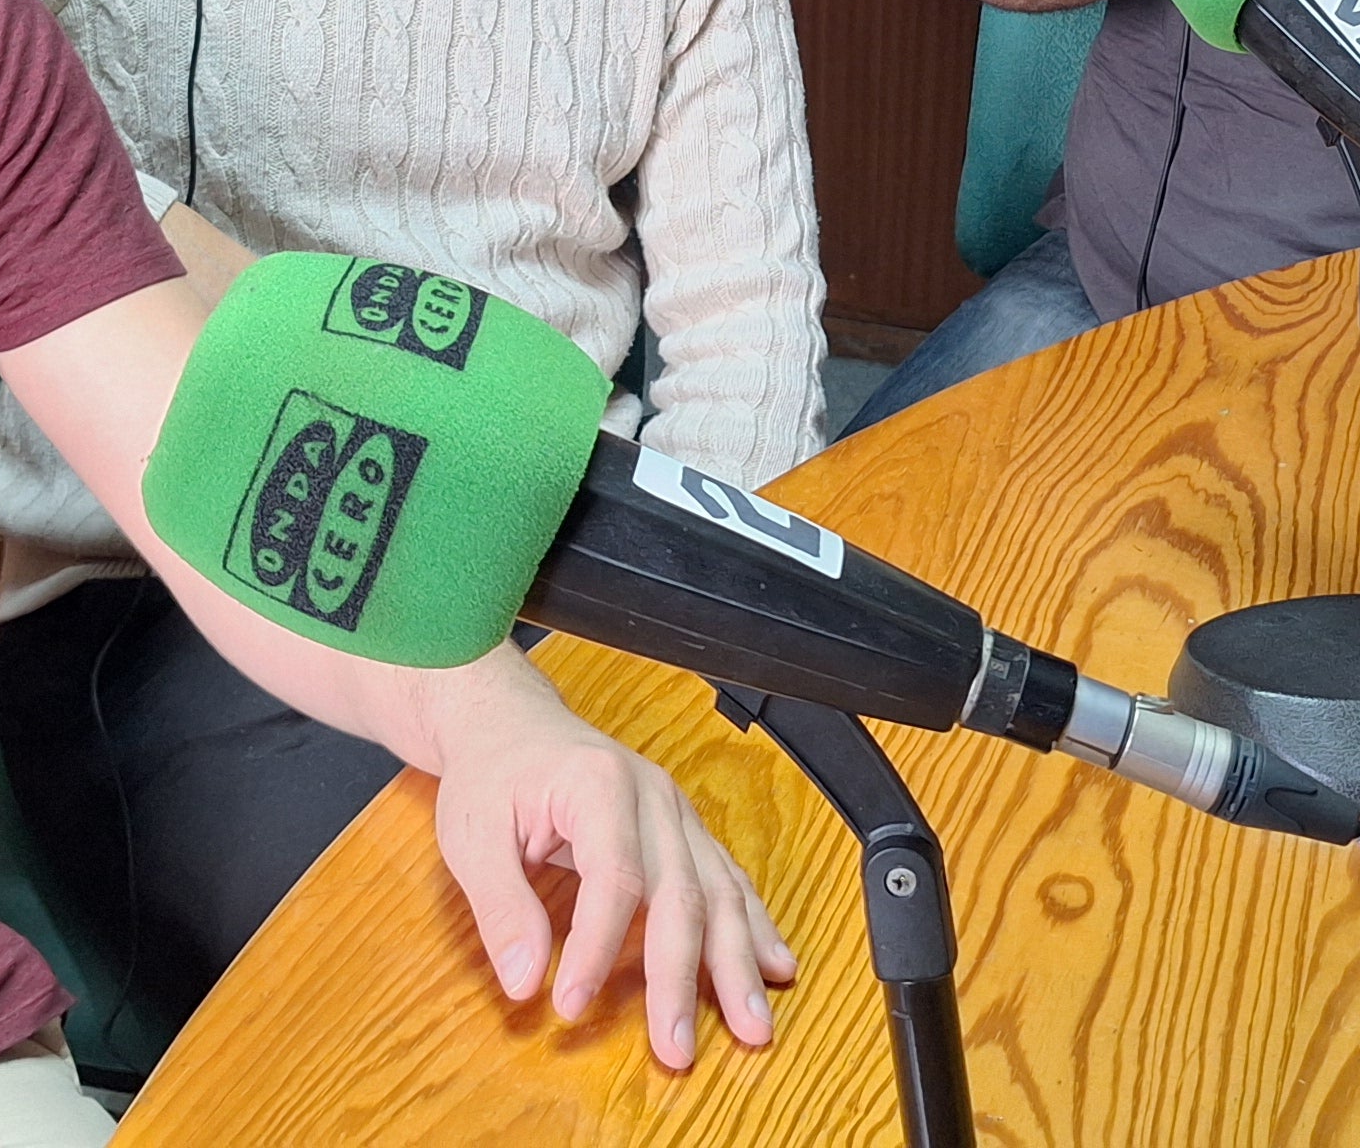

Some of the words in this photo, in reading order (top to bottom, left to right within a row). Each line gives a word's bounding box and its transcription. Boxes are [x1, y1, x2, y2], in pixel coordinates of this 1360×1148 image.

[359, 266, 405, 323] ONDA
[418, 279, 464, 335] CERO
[256, 440, 330, 573] ONDA
[312, 457, 385, 591] CERO
[680, 466, 822, 557] 2
